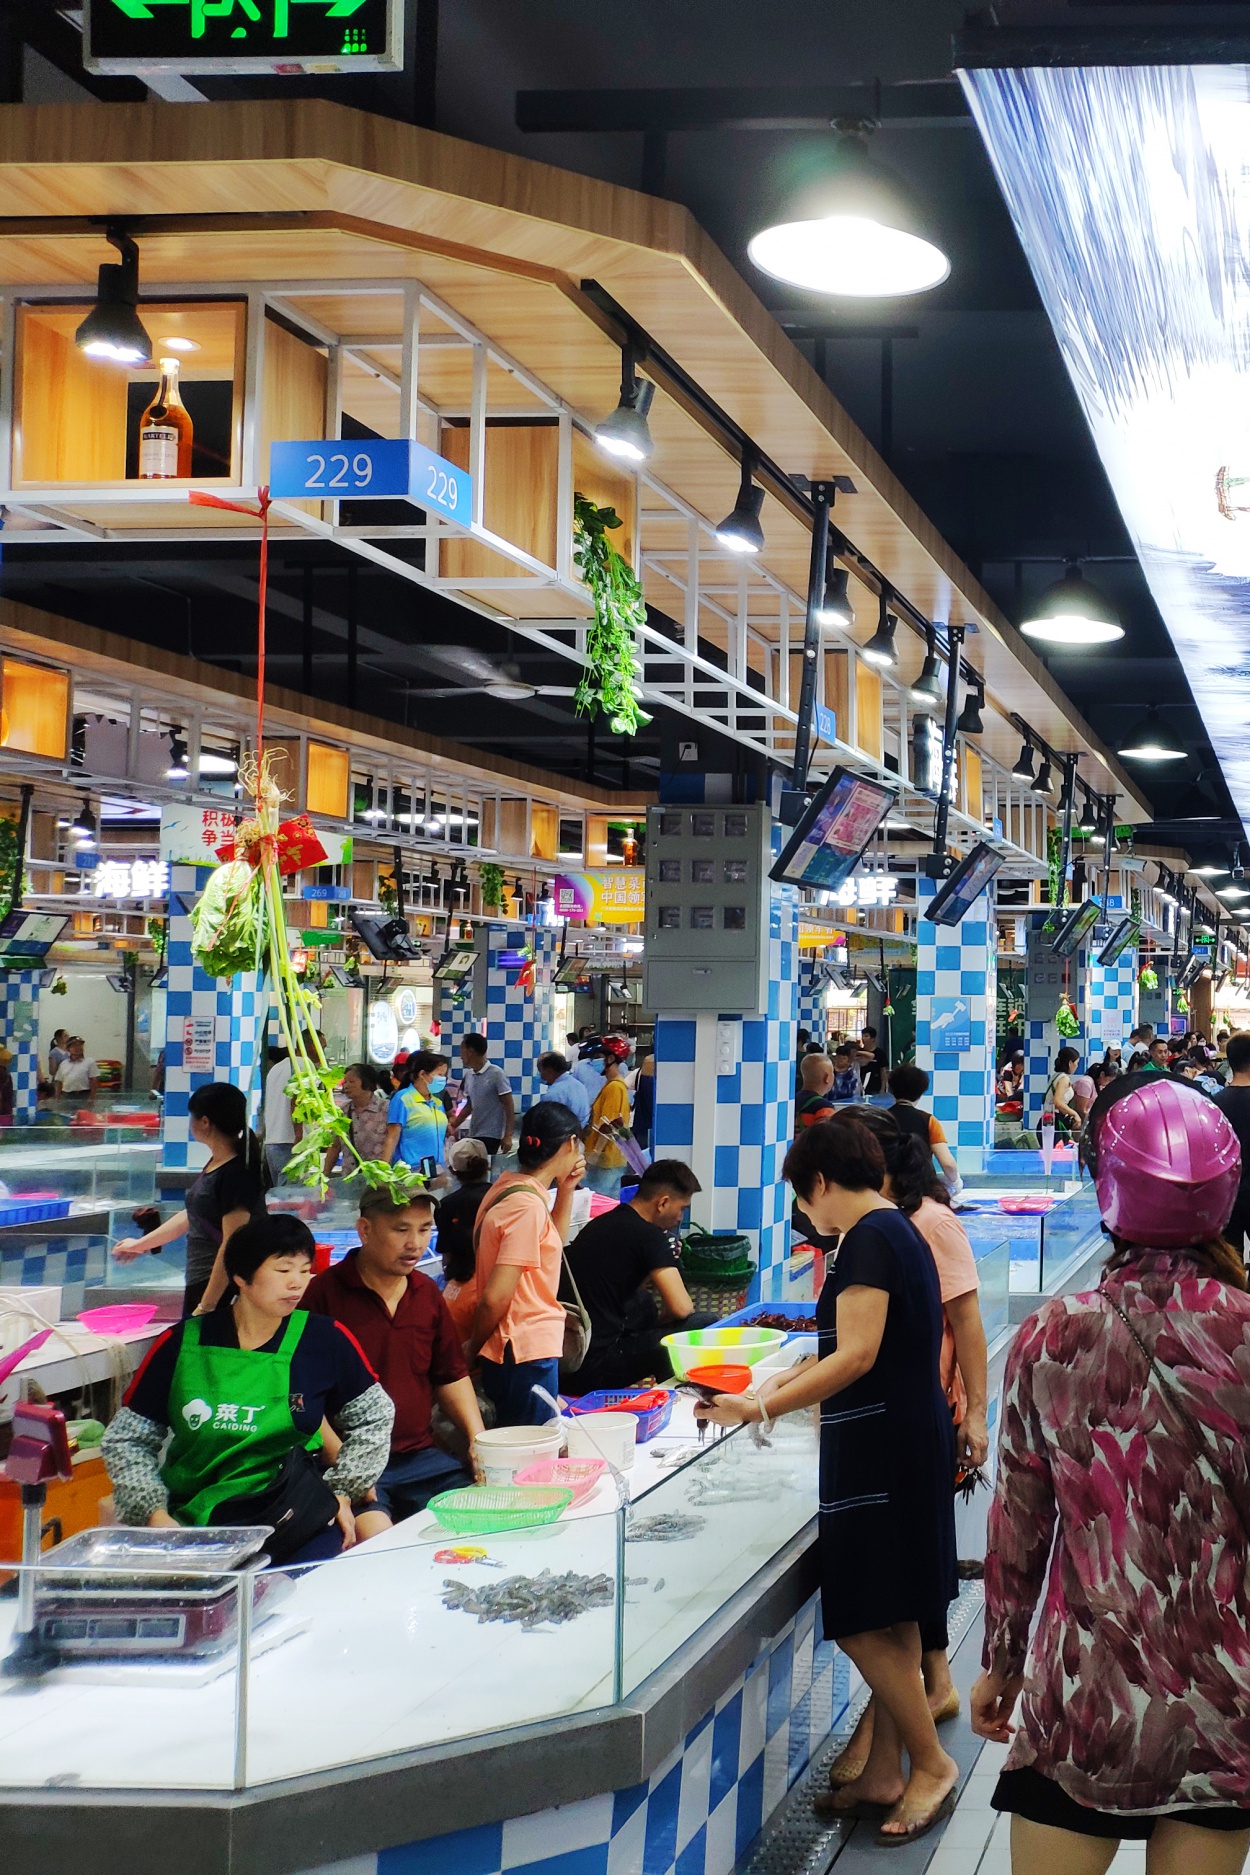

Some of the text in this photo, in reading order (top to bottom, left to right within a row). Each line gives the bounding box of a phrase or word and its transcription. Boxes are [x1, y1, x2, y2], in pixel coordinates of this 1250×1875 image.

[304, 453, 373, 488] 229
[427, 465, 458, 511] 229
[93, 860, 169, 898] 海鲜
[602, 876, 645, 890] 智慧菜
[311, 888, 327, 897] 269
[602, 890, 645, 905] 中国领
[216, 1403, 265, 1424] 菜丁
[213, 1421, 258, 1433] CAIDING
